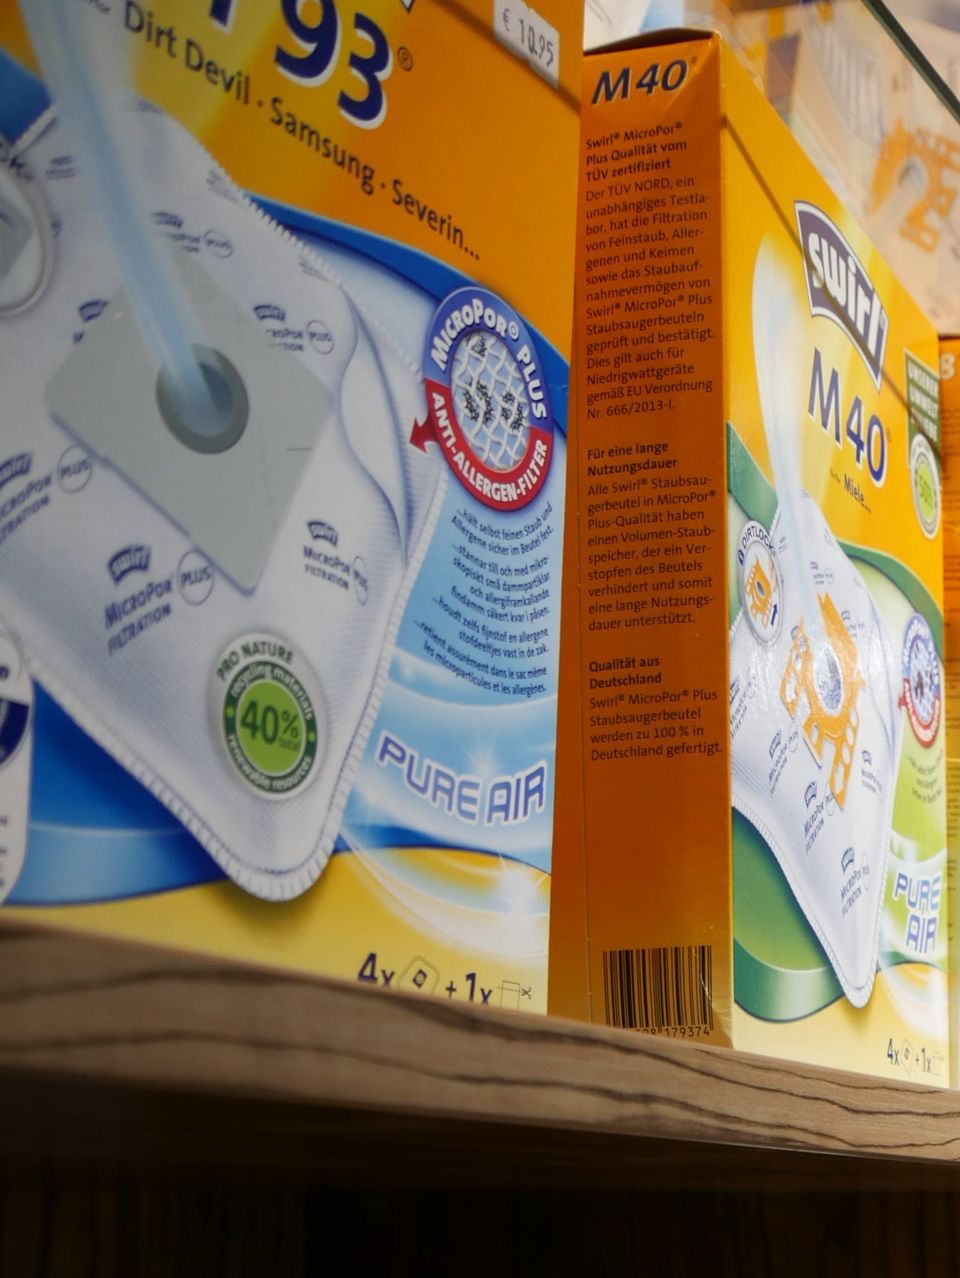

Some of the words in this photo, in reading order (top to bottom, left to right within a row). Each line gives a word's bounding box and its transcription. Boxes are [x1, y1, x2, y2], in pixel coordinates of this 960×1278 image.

[502, 8, 511, 32] €
[519, 18, 554, 68] 10.95
[591, 67, 630, 104] M
[124, 0, 177, 58] Dirt
[184, 38, 250, 105] Devil
[271, 97, 375, 195] Samsung
[586, 155, 608, 166] Plus
[611, 144, 657, 161] Qualität
[661, 141, 687, 151] vom
[586, 170, 608, 182] TÜV
[612, 159, 671, 176] zertifiziert
[586, 190, 604, 202] Der
[608, 182, 631, 197] TÜV
[676, 177, 695, 187] ein
[586, 199, 666, 219] unabhängiges
[670, 192, 710, 206] Testla-
[610, 219, 628, 231] hat
[632, 215, 648, 228] die
[652, 210, 708, 225] Filtration
[586, 241, 605, 251] von
[672, 227, 704, 239] Aller-
[586, 254, 620, 271] genen
[624, 251, 645, 264] und
[650, 246, 694, 258] Keimen
[586, 270, 618, 285] sowie
[622, 268, 640, 279] das
[644, 260, 703, 277] Staubauf-
[586, 279, 685, 302] nahmevermögen
[689, 278, 710, 288] von
[688, 293, 712, 305] Plus
[808, 232, 881, 357] swirl
[586, 312, 704, 336] Staubsaugerbeuteln
[586, 335, 628, 355] geprüft
[632, 332, 654, 346] und
[587, 357, 610, 369] Dies
[614, 353, 631, 366] gilt
[636, 349, 663, 361] auch
[667, 348, 684, 358] für
[517, 345, 547, 419] PLUS
[587, 364, 695, 385] Niedrigwattgeräte
[587, 387, 624, 405] gemäß
[627, 384, 641, 397] EU
[645, 379, 712, 395] Verordnung
[808, 347, 841, 447] M
[587, 407, 604, 419] Nr.
[432, 393, 547, 502] ANTI-ALLERGEN-FILTER
[587, 448, 605, 460] Für
[608, 445, 632, 457] eine
[636, 442, 668, 457] lange
[587, 458, 677, 477] Nutzungsdauer
[588, 484, 608, 496] Alle
[652, 476, 711, 489] Staubsau-
[588, 497, 641, 516] gerbeutel
[643, 496, 653, 507] in
[588, 511, 663, 530] Plus-Qualität
[667, 510, 704, 521] haben
[588, 535, 618, 547] einen
[642, 546, 660, 558] der
[664, 545, 682, 555] ein
[686, 543, 710, 554] Ver-
[588, 565, 636, 581] stopfen
[635, 564, 654, 575] des
[659, 560, 703, 572] Beutels
[588, 582, 648, 597] verhindert
[652, 579, 675, 591] und
[679, 577, 712, 589] somit
[589, 602, 612, 614] eine
[616, 599, 648, 613] lange
[652, 594, 713, 608] Nutzungs-
[589, 618, 620, 631] dauer
[216, 650, 241, 682] PRO
[241, 641, 294, 666] NATURE
[589, 657, 636, 672] Qualität
[640, 657, 660, 667] aus
[231, 663, 272, 698] recycling
[273, 668, 313, 721] materials
[590, 672, 662, 689] Deutschland
[693, 689, 718, 700] Plus
[240, 699, 299, 745] 40%
[590, 708, 701, 727] Staubsaugerbeutel
[591, 732, 633, 744] werden
[637, 730, 650, 739] zu
[654, 728, 675, 738] 100
[679, 727, 689, 736] %
[693, 726, 703, 735] in
[591, 745, 663, 761] Deutschland
[894, 871, 941, 912] PURE
[906, 913, 938, 954] AIR
